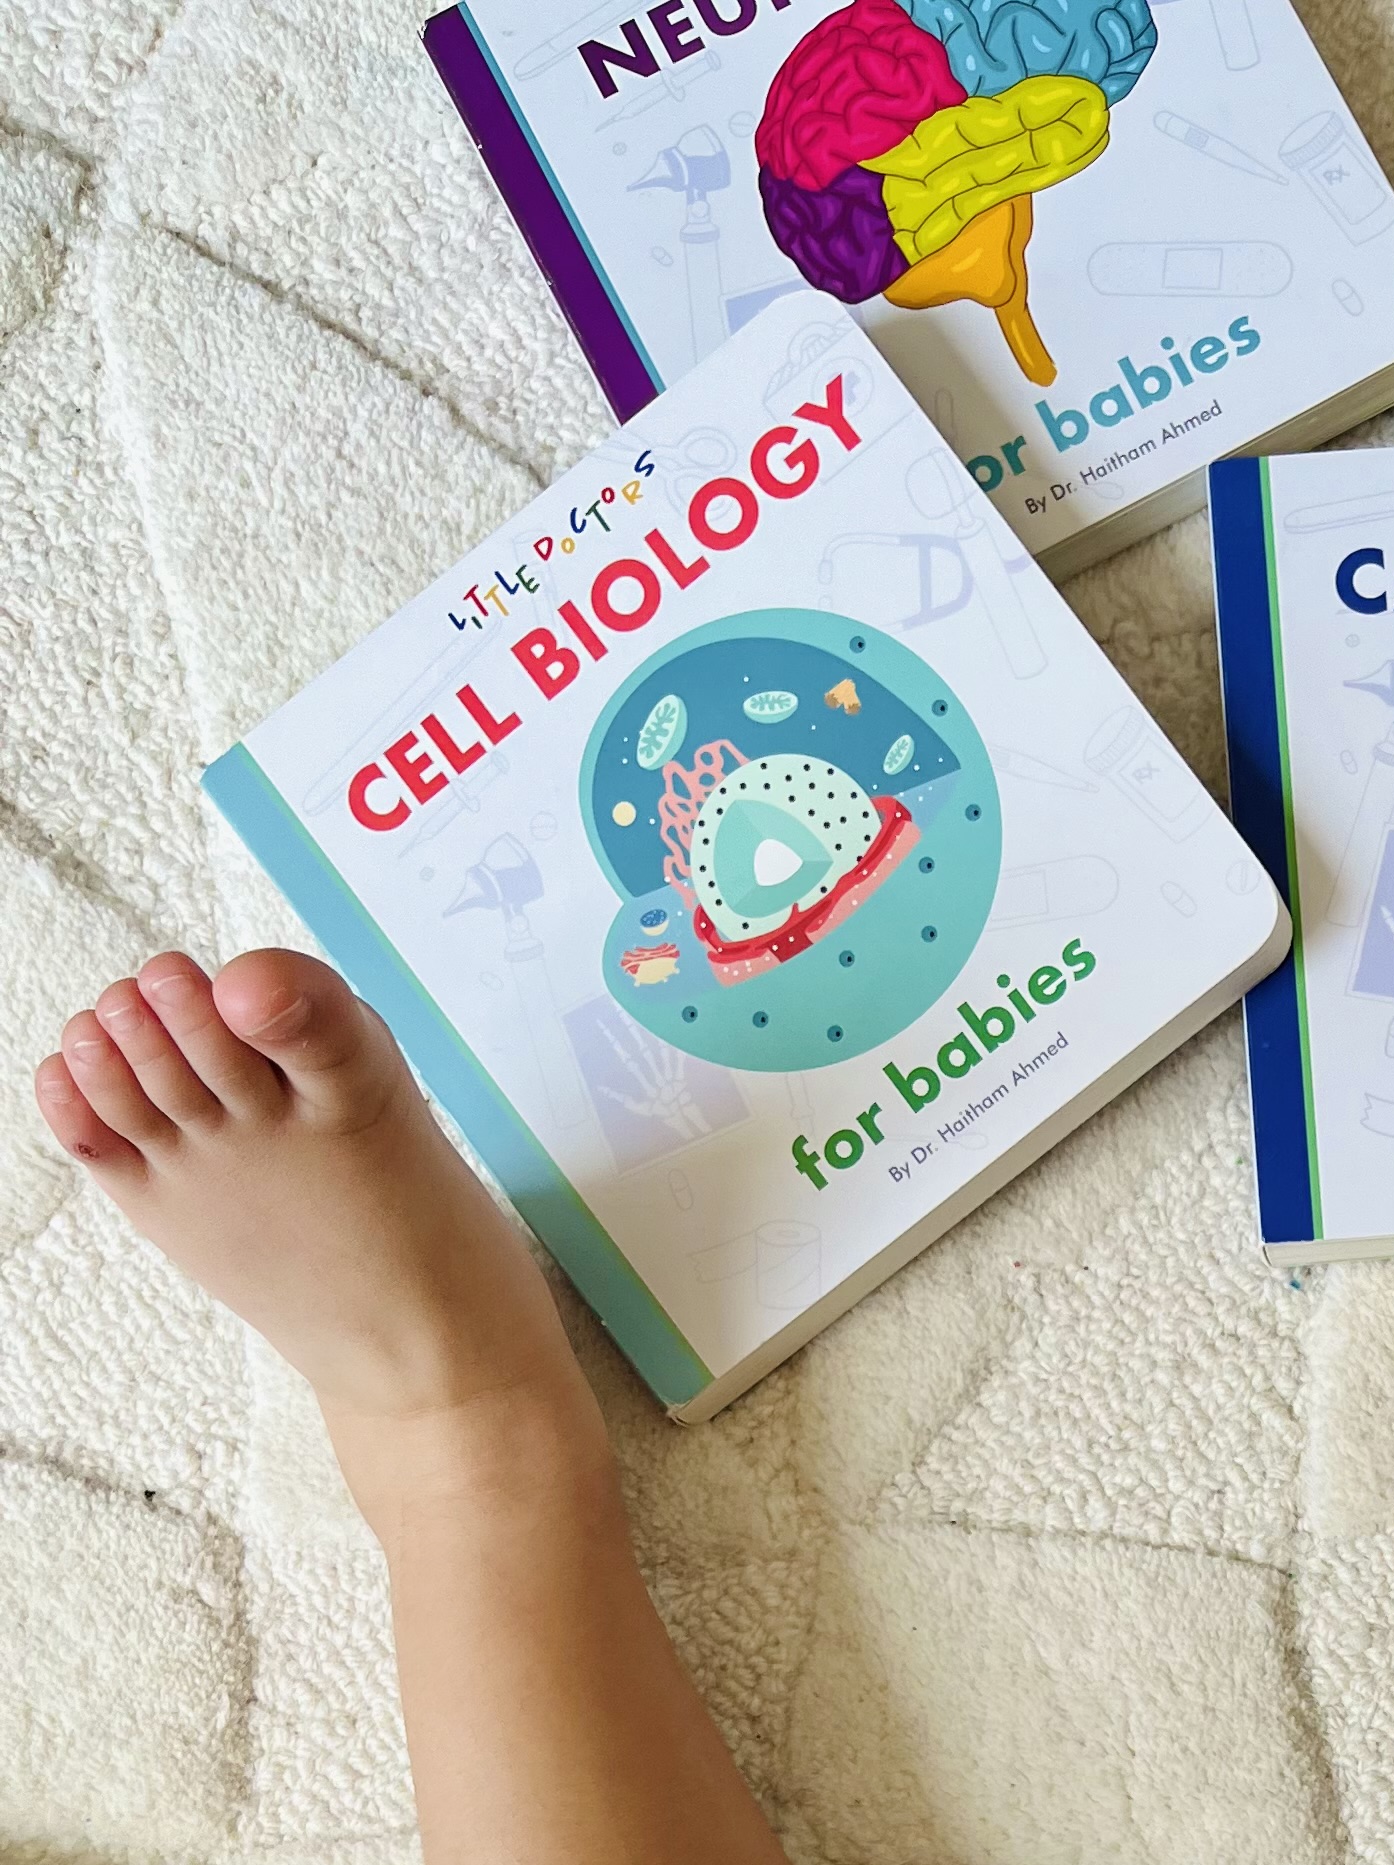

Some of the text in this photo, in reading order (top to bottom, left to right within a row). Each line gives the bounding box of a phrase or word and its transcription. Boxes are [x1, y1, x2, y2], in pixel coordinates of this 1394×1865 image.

[577, 0, 791, 98] NEU
[965, 316, 1260, 493] or babies
[1025, 399, 1223, 515] By Dr. Haitham Ahmed
[348, 373, 862, 832] CELL BIOLOGY
[448, 450, 655, 630] LITTLE DOCTORS
[792, 938, 1096, 1191] for babies
[888, 1031, 1070, 1183] By Dr. Haitham Ahmed
